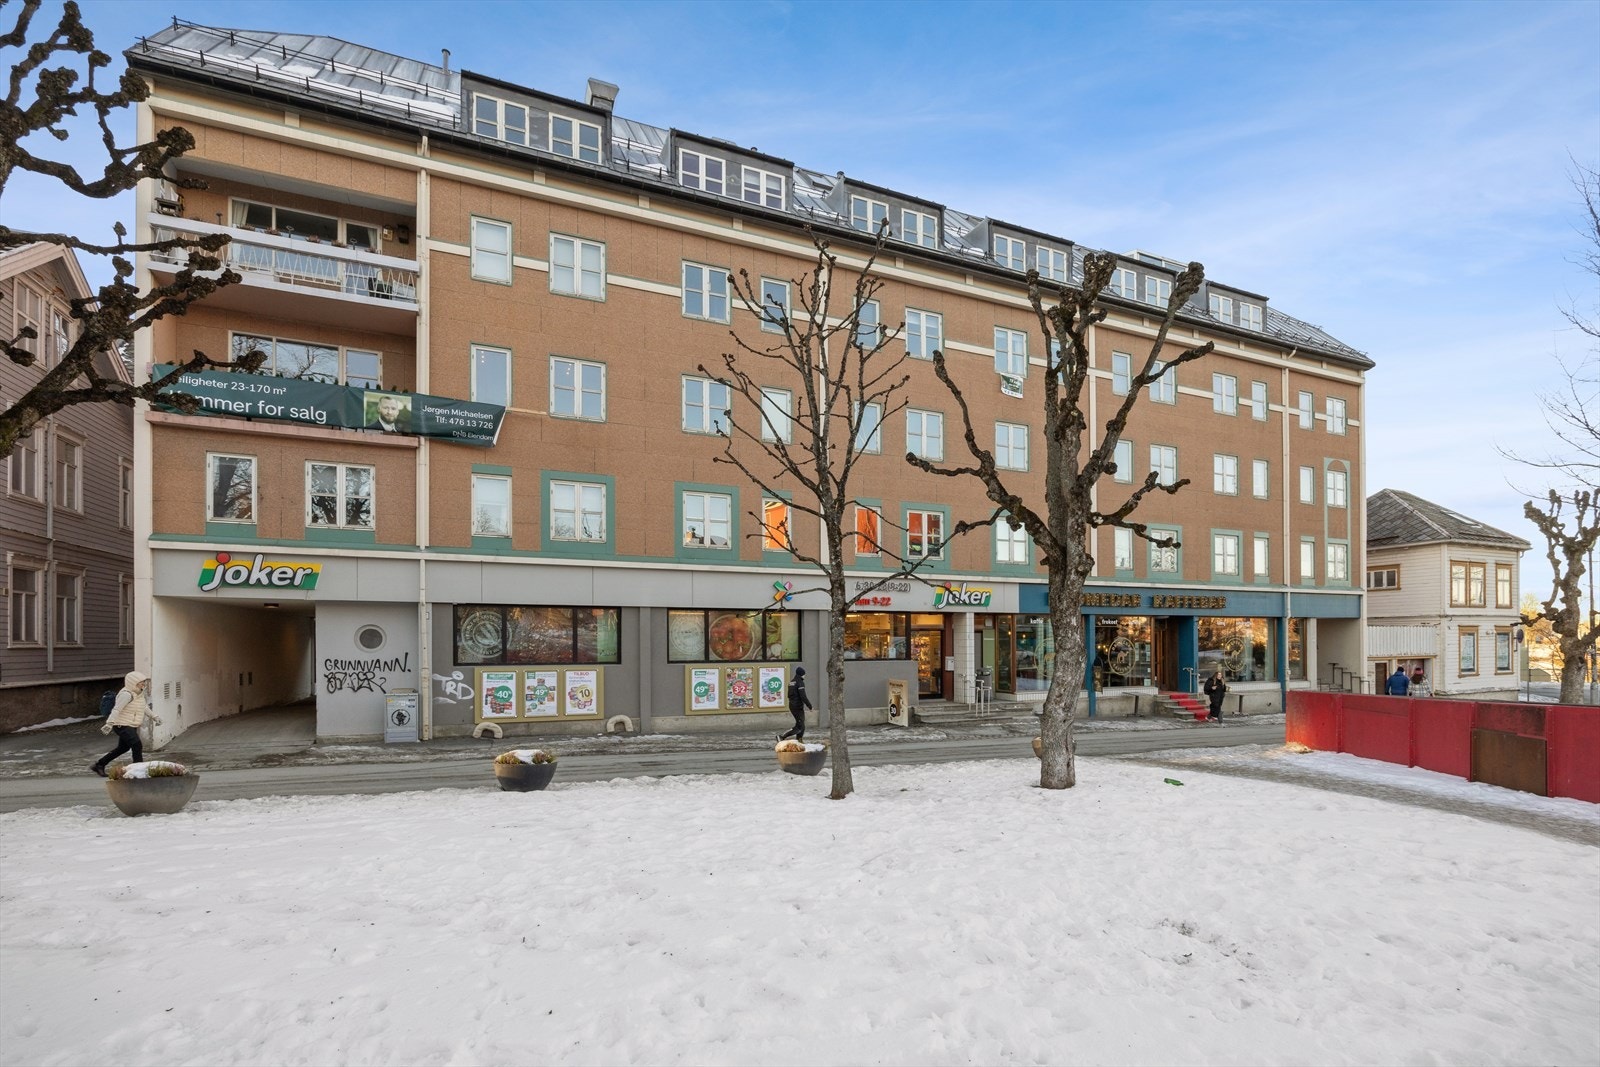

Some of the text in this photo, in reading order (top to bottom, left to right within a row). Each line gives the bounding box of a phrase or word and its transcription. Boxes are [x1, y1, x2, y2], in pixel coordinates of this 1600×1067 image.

[178, 375, 228, 389] eiligheter
[231, 381, 271, 393] 23-170
[169, 389, 327, 424] mmer for salg
[422, 405, 493, 420] Jørgen Michaelsen
[435, 415, 448, 424] Tlf:
[448, 418, 465, 426] 476
[478, 421, 493, 430] 726
[201, 552, 313, 591] joker
[936, 582, 990, 609] joker
[579, 688, 591, 698] 10
